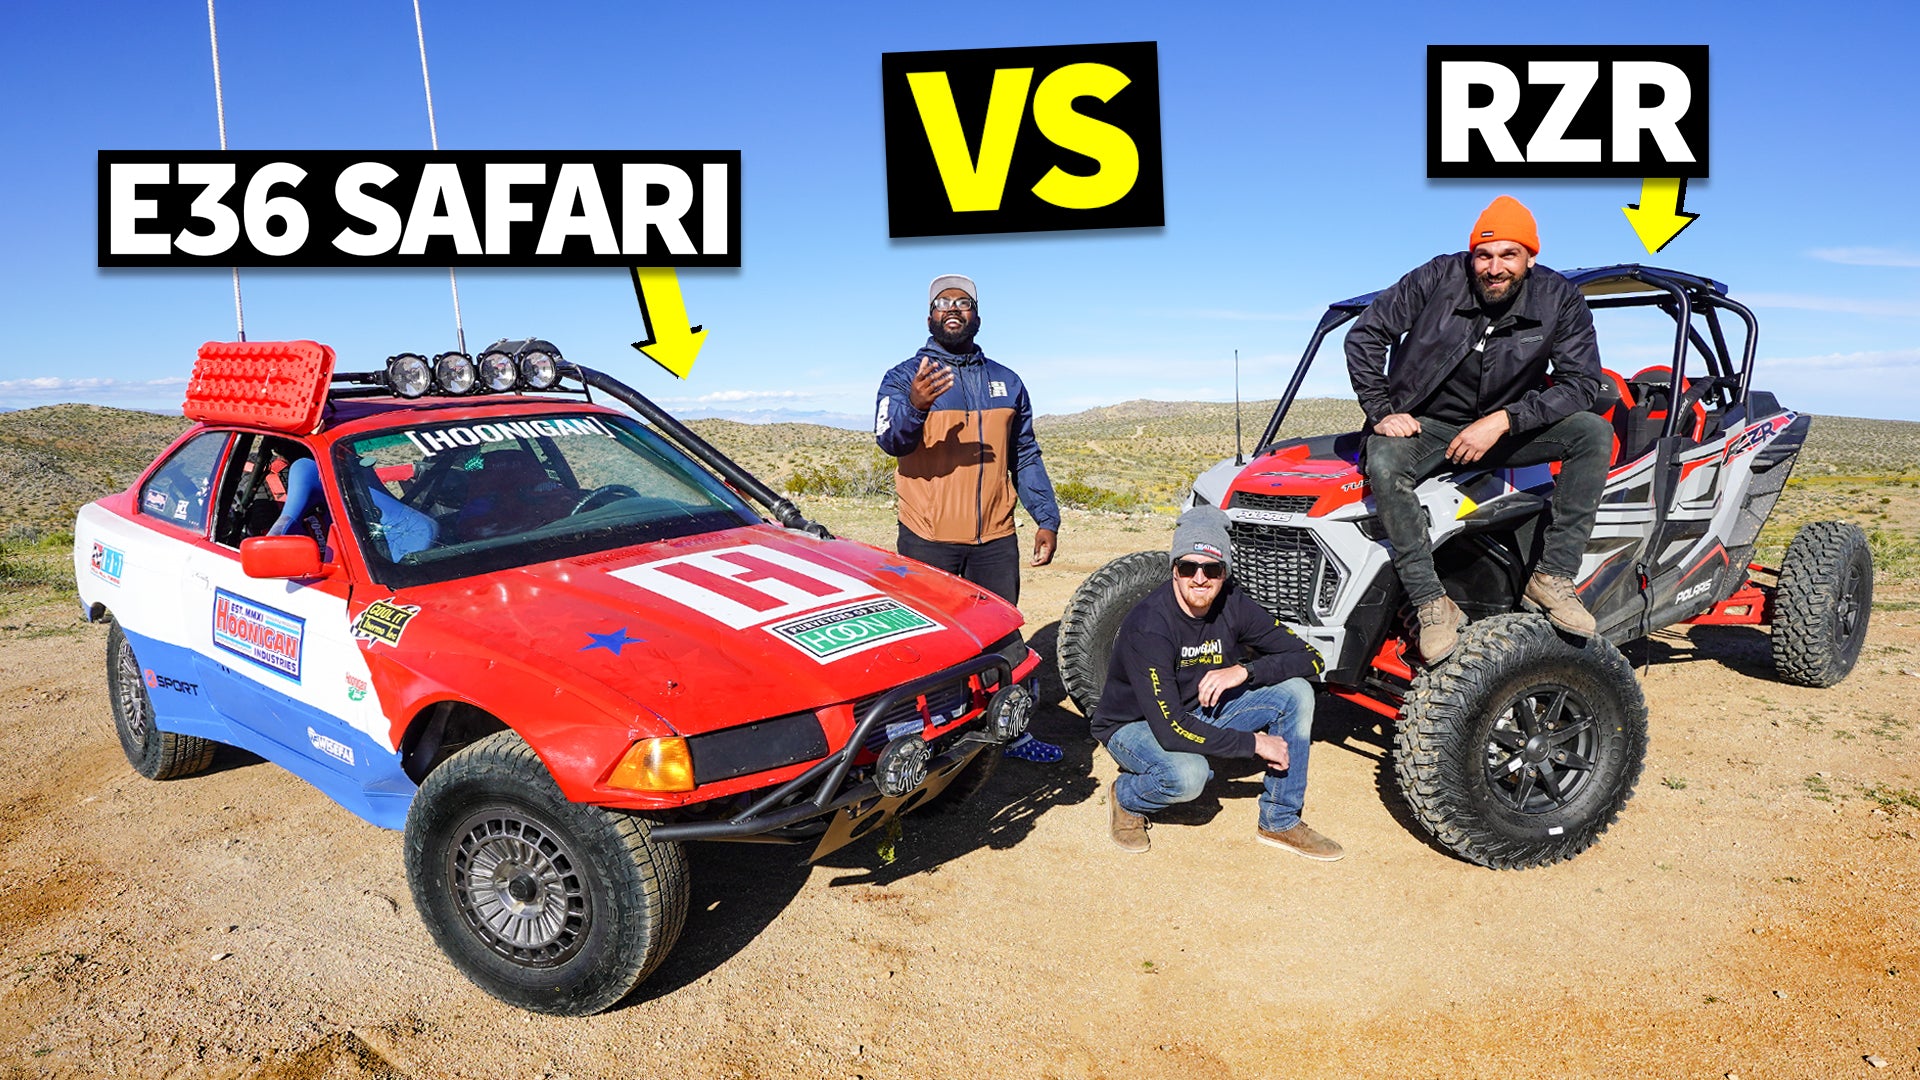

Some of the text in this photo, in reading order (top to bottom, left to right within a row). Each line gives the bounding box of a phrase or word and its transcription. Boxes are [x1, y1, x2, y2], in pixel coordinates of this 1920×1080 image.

[404, 416, 616, 457] [HOONIGAN]
[1236, 510, 1293, 522] POLARIS
[652, 551, 845, 613] H
[1674, 578, 1713, 605] POLARIS
[231, 602, 243, 615] EST.
[369, 604, 405, 624] COOL IT
[216, 596, 299, 661] HOONIGAN
[788, 611, 852, 634] PURVEYORS
[254, 647, 297, 673] INDUSTRIES
[156, 675, 198, 696] SPORT
[1008, 697, 1033, 737] KC
[898, 748, 931, 793] KC
